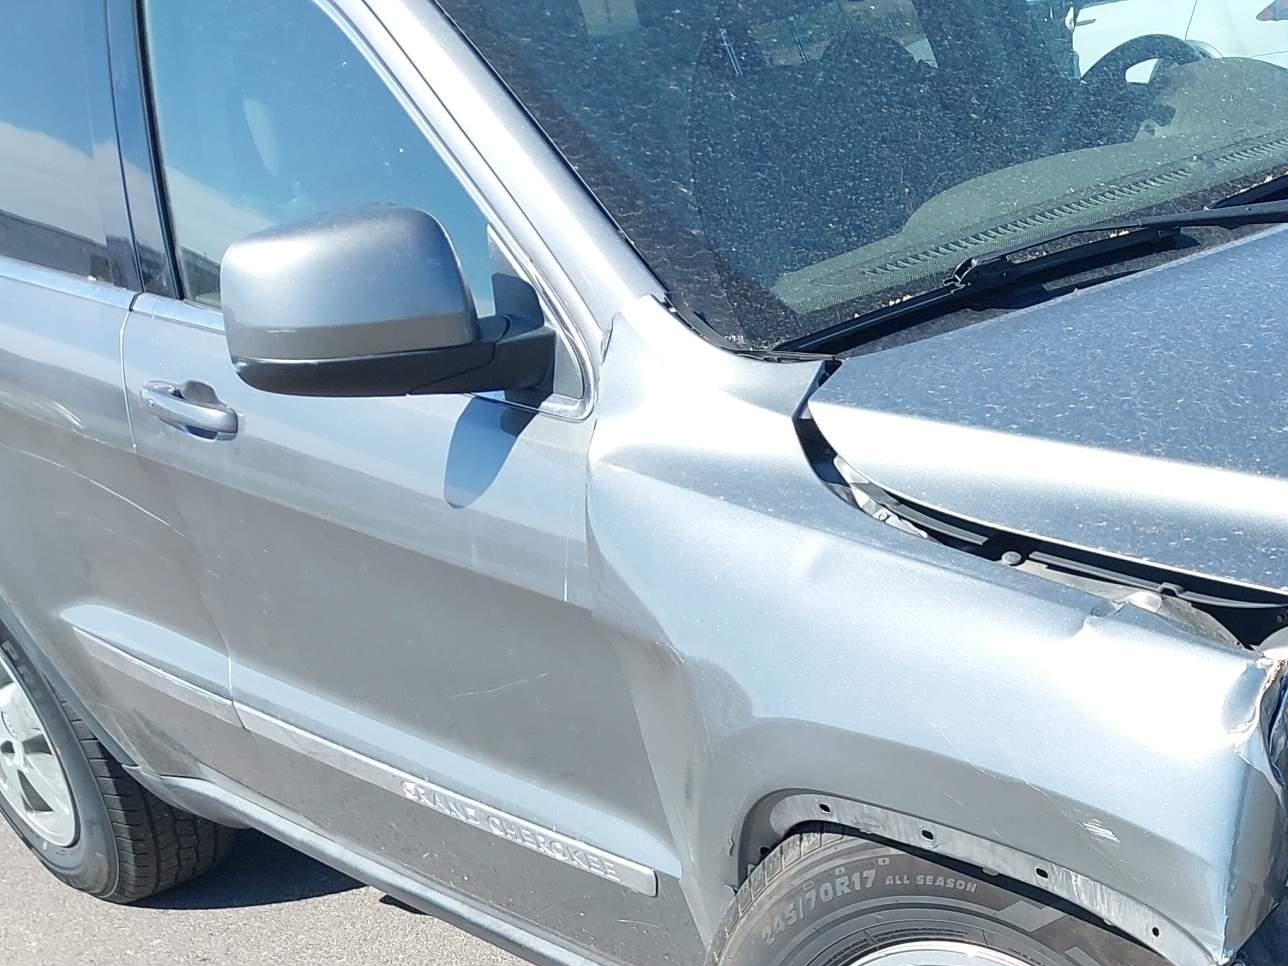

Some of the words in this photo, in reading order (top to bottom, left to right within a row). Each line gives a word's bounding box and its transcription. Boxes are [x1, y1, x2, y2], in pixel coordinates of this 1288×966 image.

[401, 780, 480, 826] GRAND
[487, 815, 621, 882] CHEROKEE
[762, 868, 876, 945] 245/70R17
[885, 874, 910, 886] ALL
[916, 874, 977, 893] SEASON
